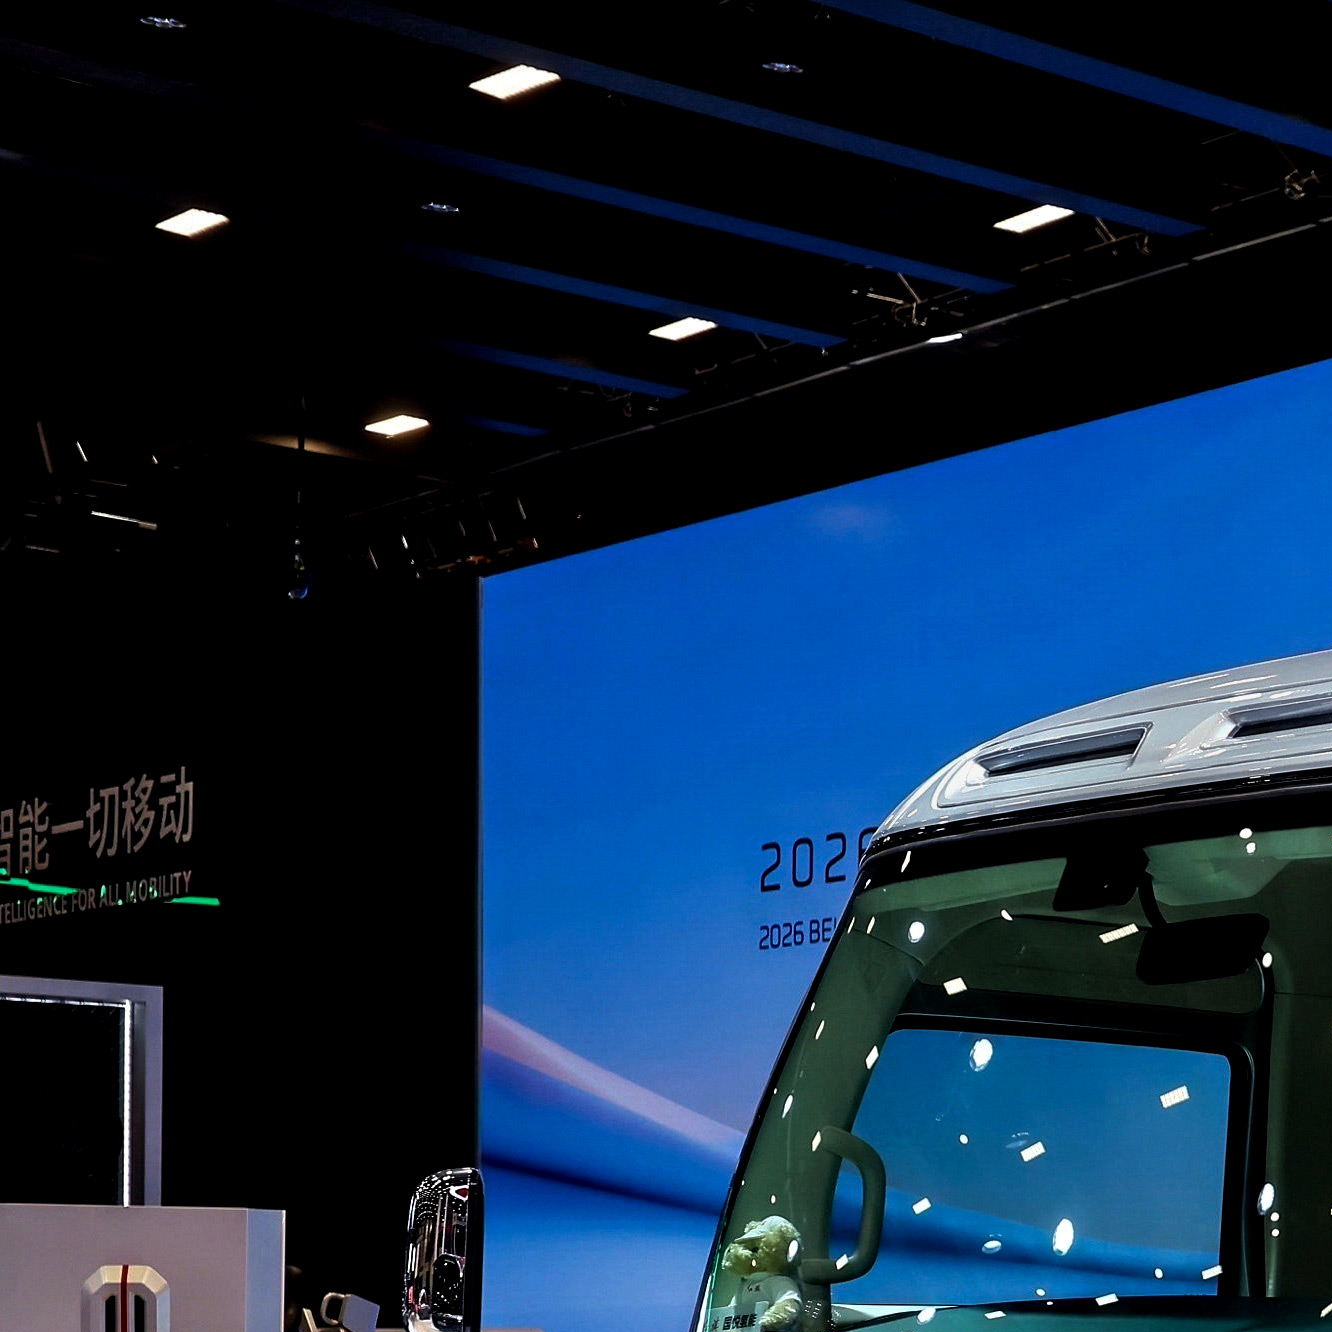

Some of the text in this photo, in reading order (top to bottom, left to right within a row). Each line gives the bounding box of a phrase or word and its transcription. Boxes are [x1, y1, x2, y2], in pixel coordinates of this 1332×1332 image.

[72, 888, 96, 913] FOR
[99, 882, 120, 909] ALL
[125, 870, 192, 903] MOBILITY
[760, 920, 805, 950] 2026
